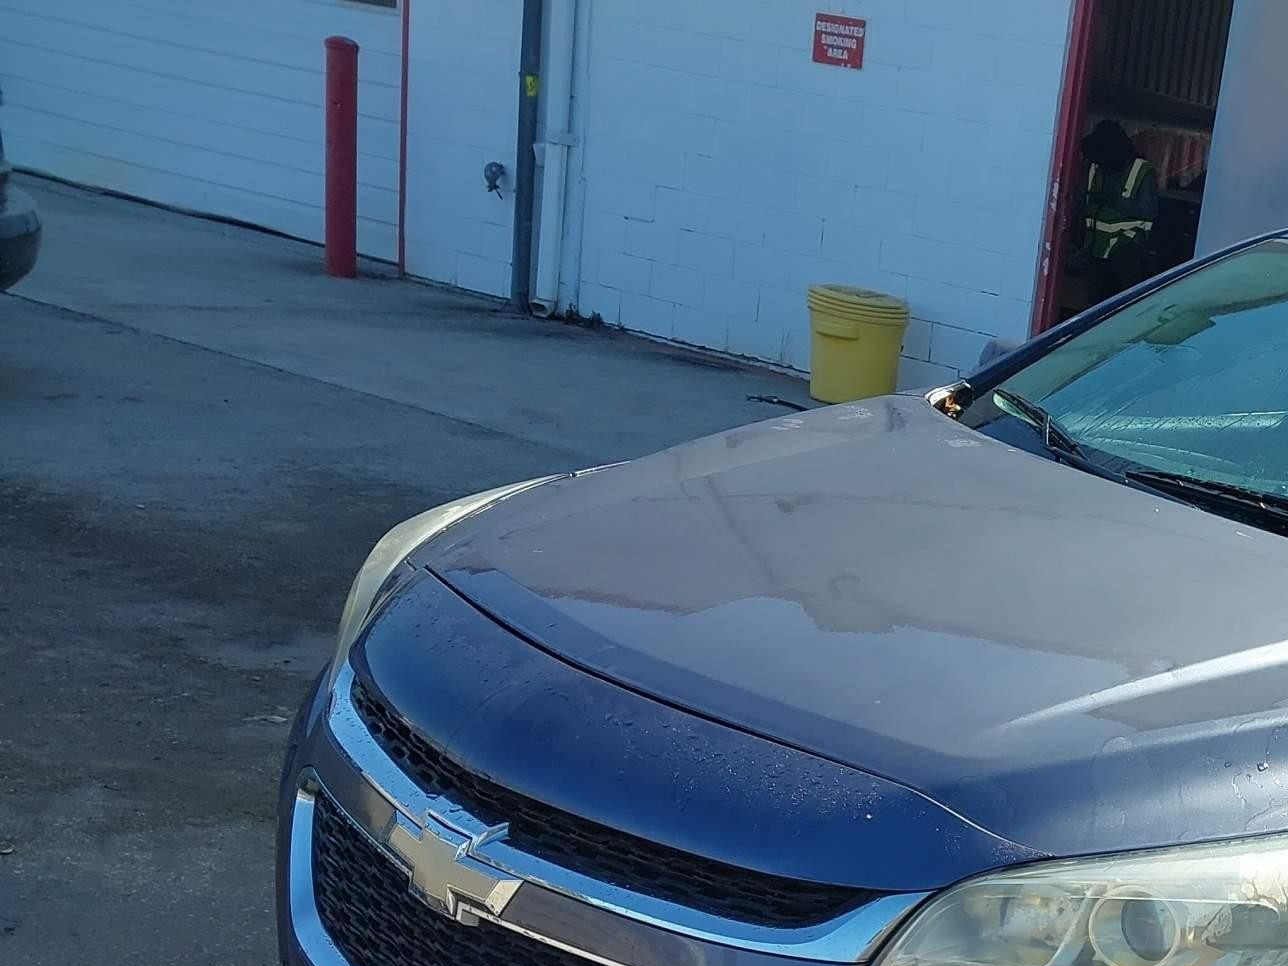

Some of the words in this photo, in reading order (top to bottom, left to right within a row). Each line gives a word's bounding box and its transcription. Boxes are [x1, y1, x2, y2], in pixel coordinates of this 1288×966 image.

[816, 20, 865, 37] DESIGNATED
[820, 34, 857, 49] SMOKING
[827, 47, 849, 60] AREA
